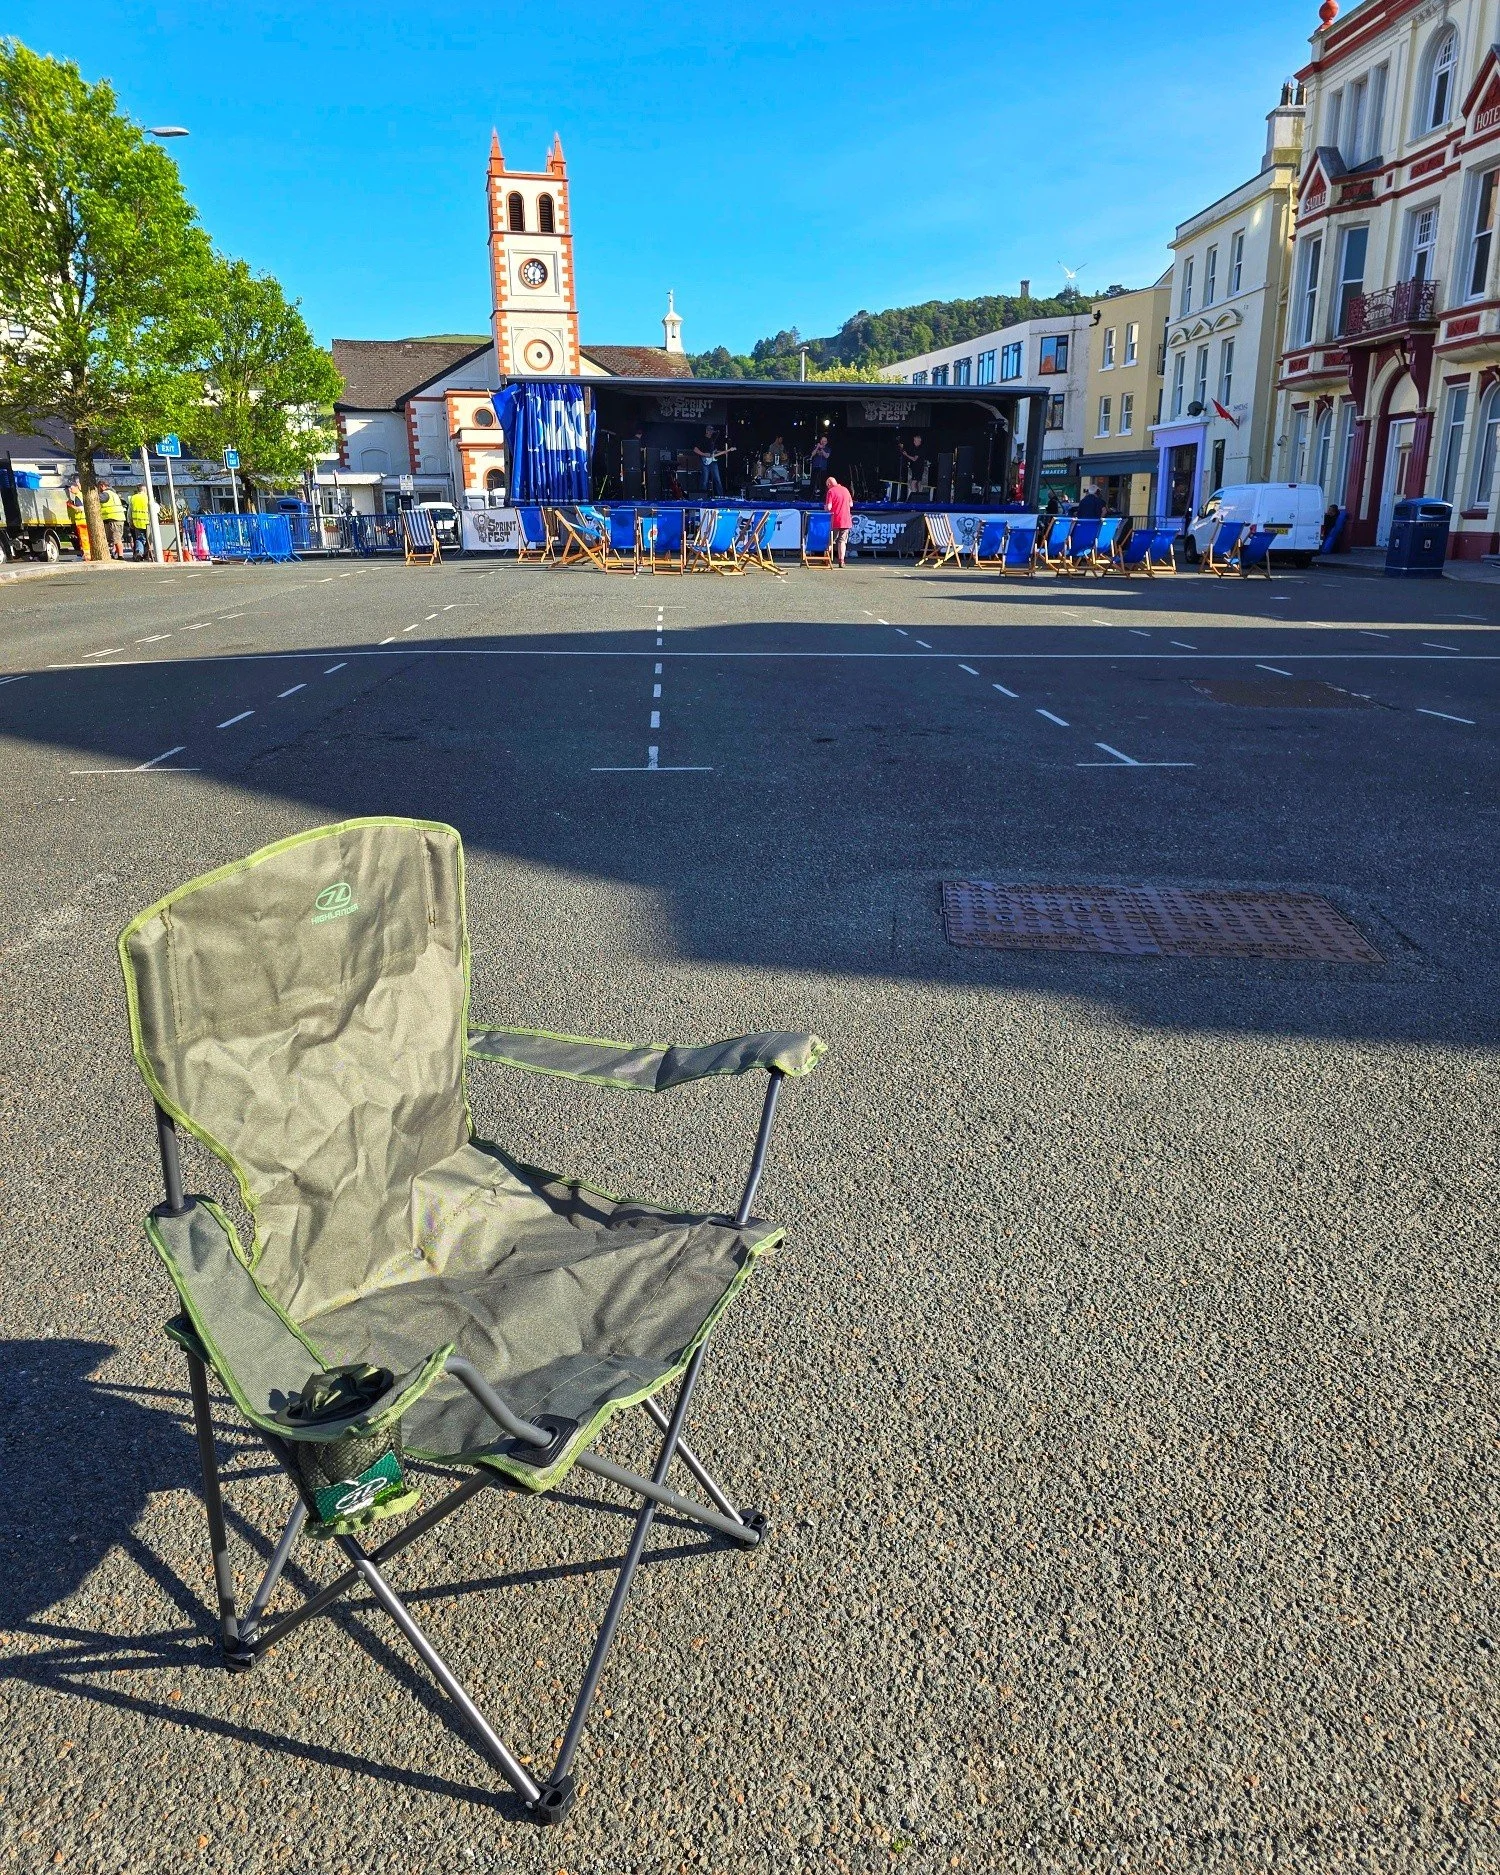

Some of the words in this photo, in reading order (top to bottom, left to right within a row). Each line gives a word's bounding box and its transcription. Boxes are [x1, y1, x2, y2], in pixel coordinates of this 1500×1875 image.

[674, 397, 713, 409] SPRINT
[879, 400, 918, 411] SPRINT
[674, 408, 705, 418] FEST
[878, 411, 908, 421] FEST
[161, 445, 175, 453] EXIT
[488, 518, 517, 532] SPRINT
[864, 520, 907, 534] SPRINT
[488, 531, 511, 543] FEST
[863, 533, 897, 545] FEST
[311, 903, 359, 925] HIGHLANDER
